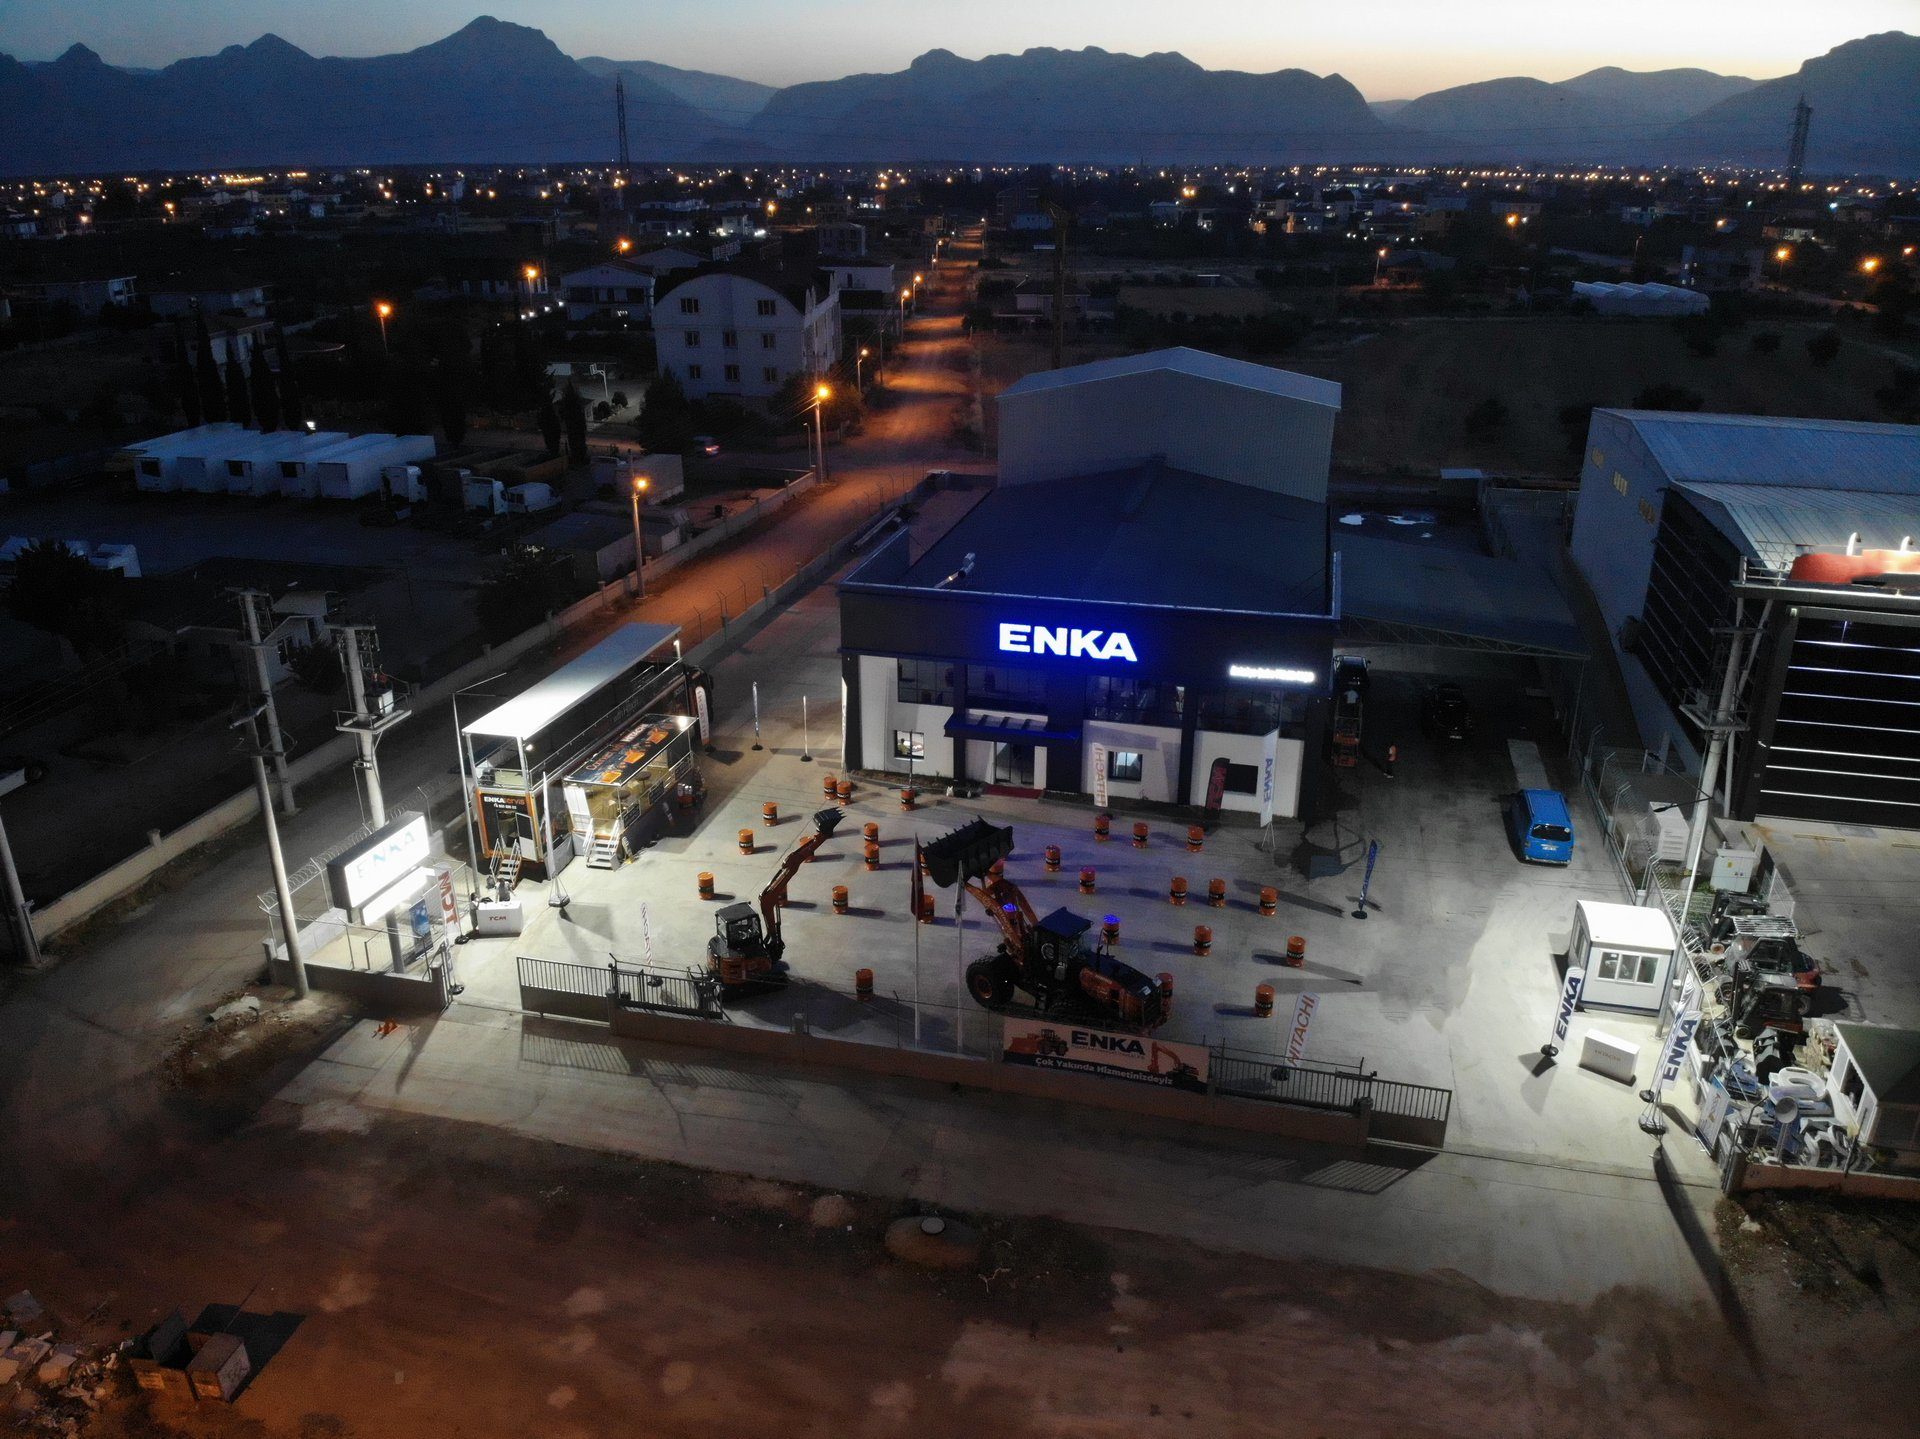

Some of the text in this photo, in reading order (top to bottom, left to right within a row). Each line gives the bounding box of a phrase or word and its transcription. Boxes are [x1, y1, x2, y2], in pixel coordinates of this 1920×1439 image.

[999, 622, 1137, 662] ENKA
[1287, 995, 1315, 1067] HITACHI
[1555, 976, 1581, 1041] ENKA
[1072, 1030, 1145, 1055] ENKA
[1663, 1019, 1698, 1081] ENKA
[1035, 1057, 1173, 1085] Çok Yakında Hizmetinizdeyiz
